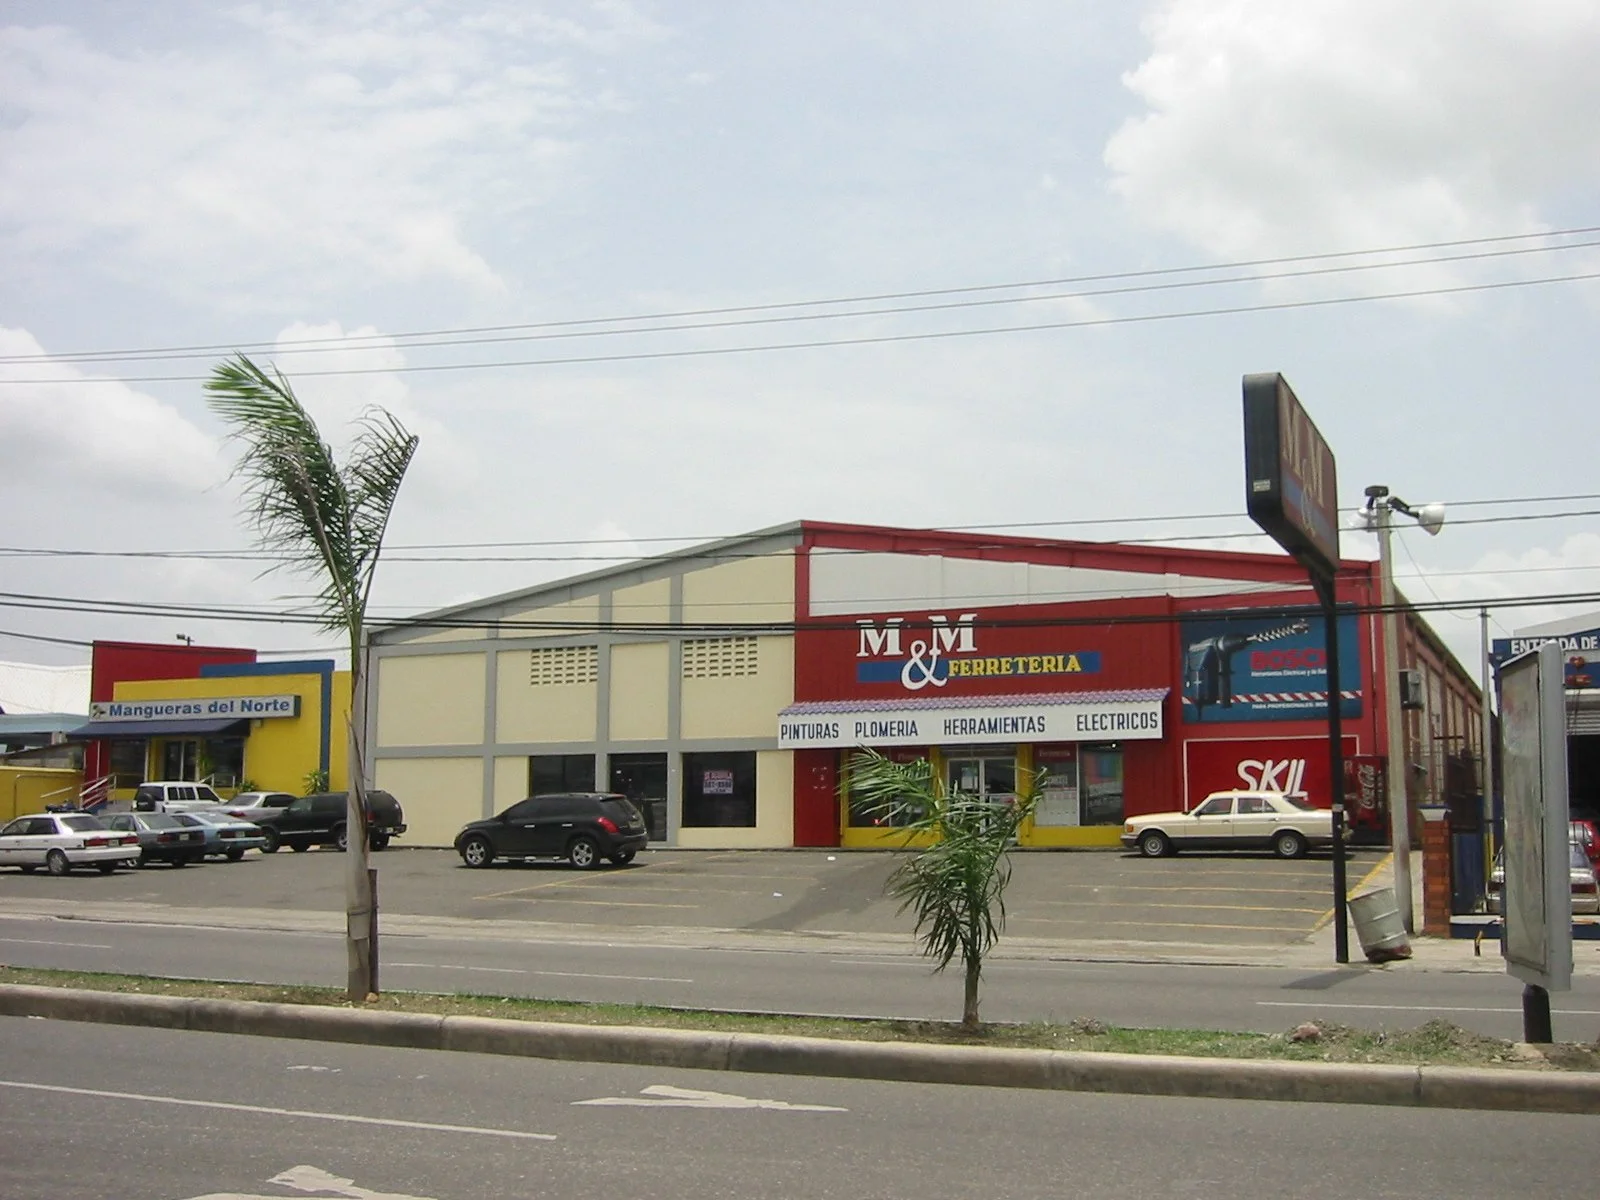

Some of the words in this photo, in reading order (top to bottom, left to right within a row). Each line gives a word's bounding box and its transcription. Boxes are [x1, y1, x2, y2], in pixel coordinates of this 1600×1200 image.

[1510, 637, 1579, 655] ENTDA
[1580, 635, 1598, 650] DE
[948, 655, 1081, 677] FERRETERIA
[109, 703, 202, 718] Mangueras
[208, 701, 233, 713] del
[240, 699, 290, 712] Norte
[781, 723, 839, 740] PINTURAS
[855, 720, 918, 738] PLOMERIA
[944, 716, 1045, 735] HERRAMIENTAS
[1076, 712, 1158, 731] ELECTRICOS
[1237, 759, 1308, 800] SKIL
